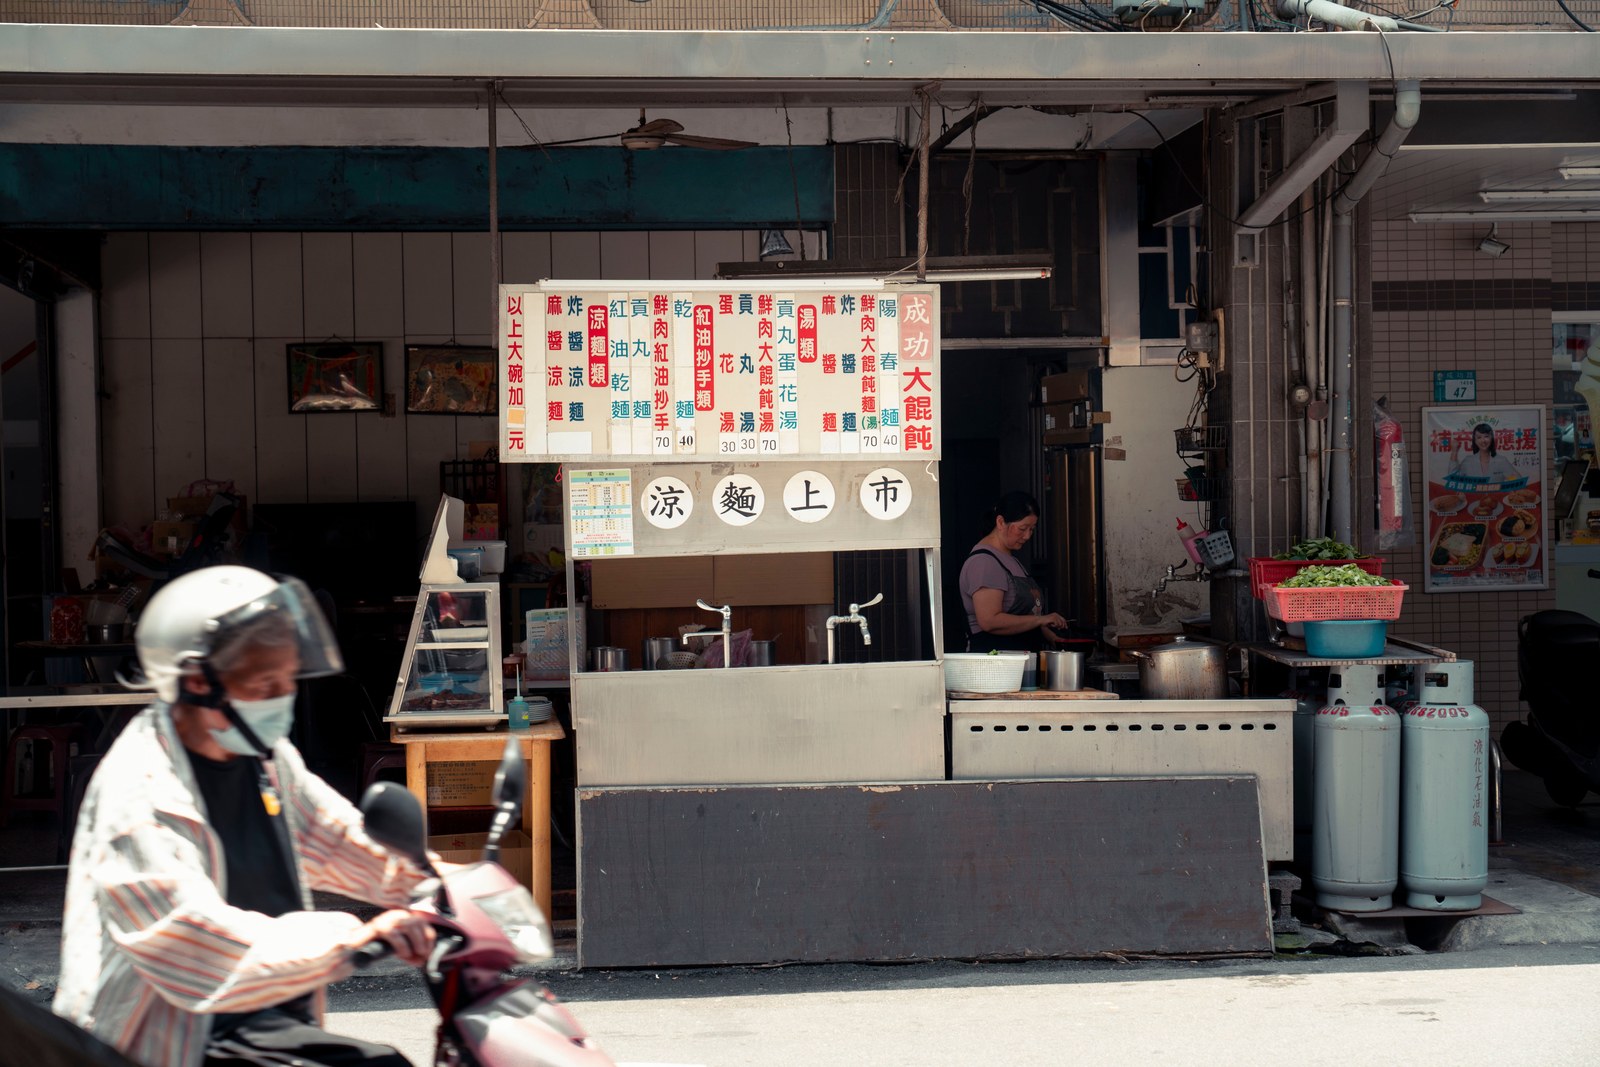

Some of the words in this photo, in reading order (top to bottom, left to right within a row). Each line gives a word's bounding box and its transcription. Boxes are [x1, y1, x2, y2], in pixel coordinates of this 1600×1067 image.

[507, 296, 524, 450] 以上大碗加元
[547, 295, 564, 421] 麻醬涼麵
[567, 295, 585, 422] 炸醬涼麵
[590, 308, 607, 385] 涼麵類
[609, 299, 630, 419] 紅油乾麵
[630, 298, 651, 419] 貢丸麵
[653, 294, 669, 431] 鮮肉紅油抄手
[674, 299, 695, 419] 乾麵
[695, 307, 712, 409] 紅油抄手類
[719, 294, 735, 432] 蛋花湯
[738, 293, 755, 432] 貢丸湯
[758, 294, 774, 433] 鮮肉大餛飩湯
[776, 299, 798, 430] 貢丸蛋花湯
[799, 308, 815, 359] 湯類
[821, 295, 837, 432] 麻醬麵
[841, 294, 857, 432] 炸醬麵
[860, 294, 876, 413] 鮮肉大餛飩麵
[878, 299, 900, 427] 陽春麵
[903, 296, 930, 358] 成功
[655, 436, 670, 448] 70
[679, 435, 694, 446] 40
[721, 441, 736, 452] 30
[740, 438, 755, 450] 30
[762, 439, 777, 451] 70
[863, 435, 878, 447] 70
[883, 434, 898, 446] 40
[903, 366, 933, 451] 大餛飩
[1453, 386, 1467, 398] 47
[649, 475, 904, 520] 涼麵上市
[1472, 738, 1484, 828] 液化石油氣
